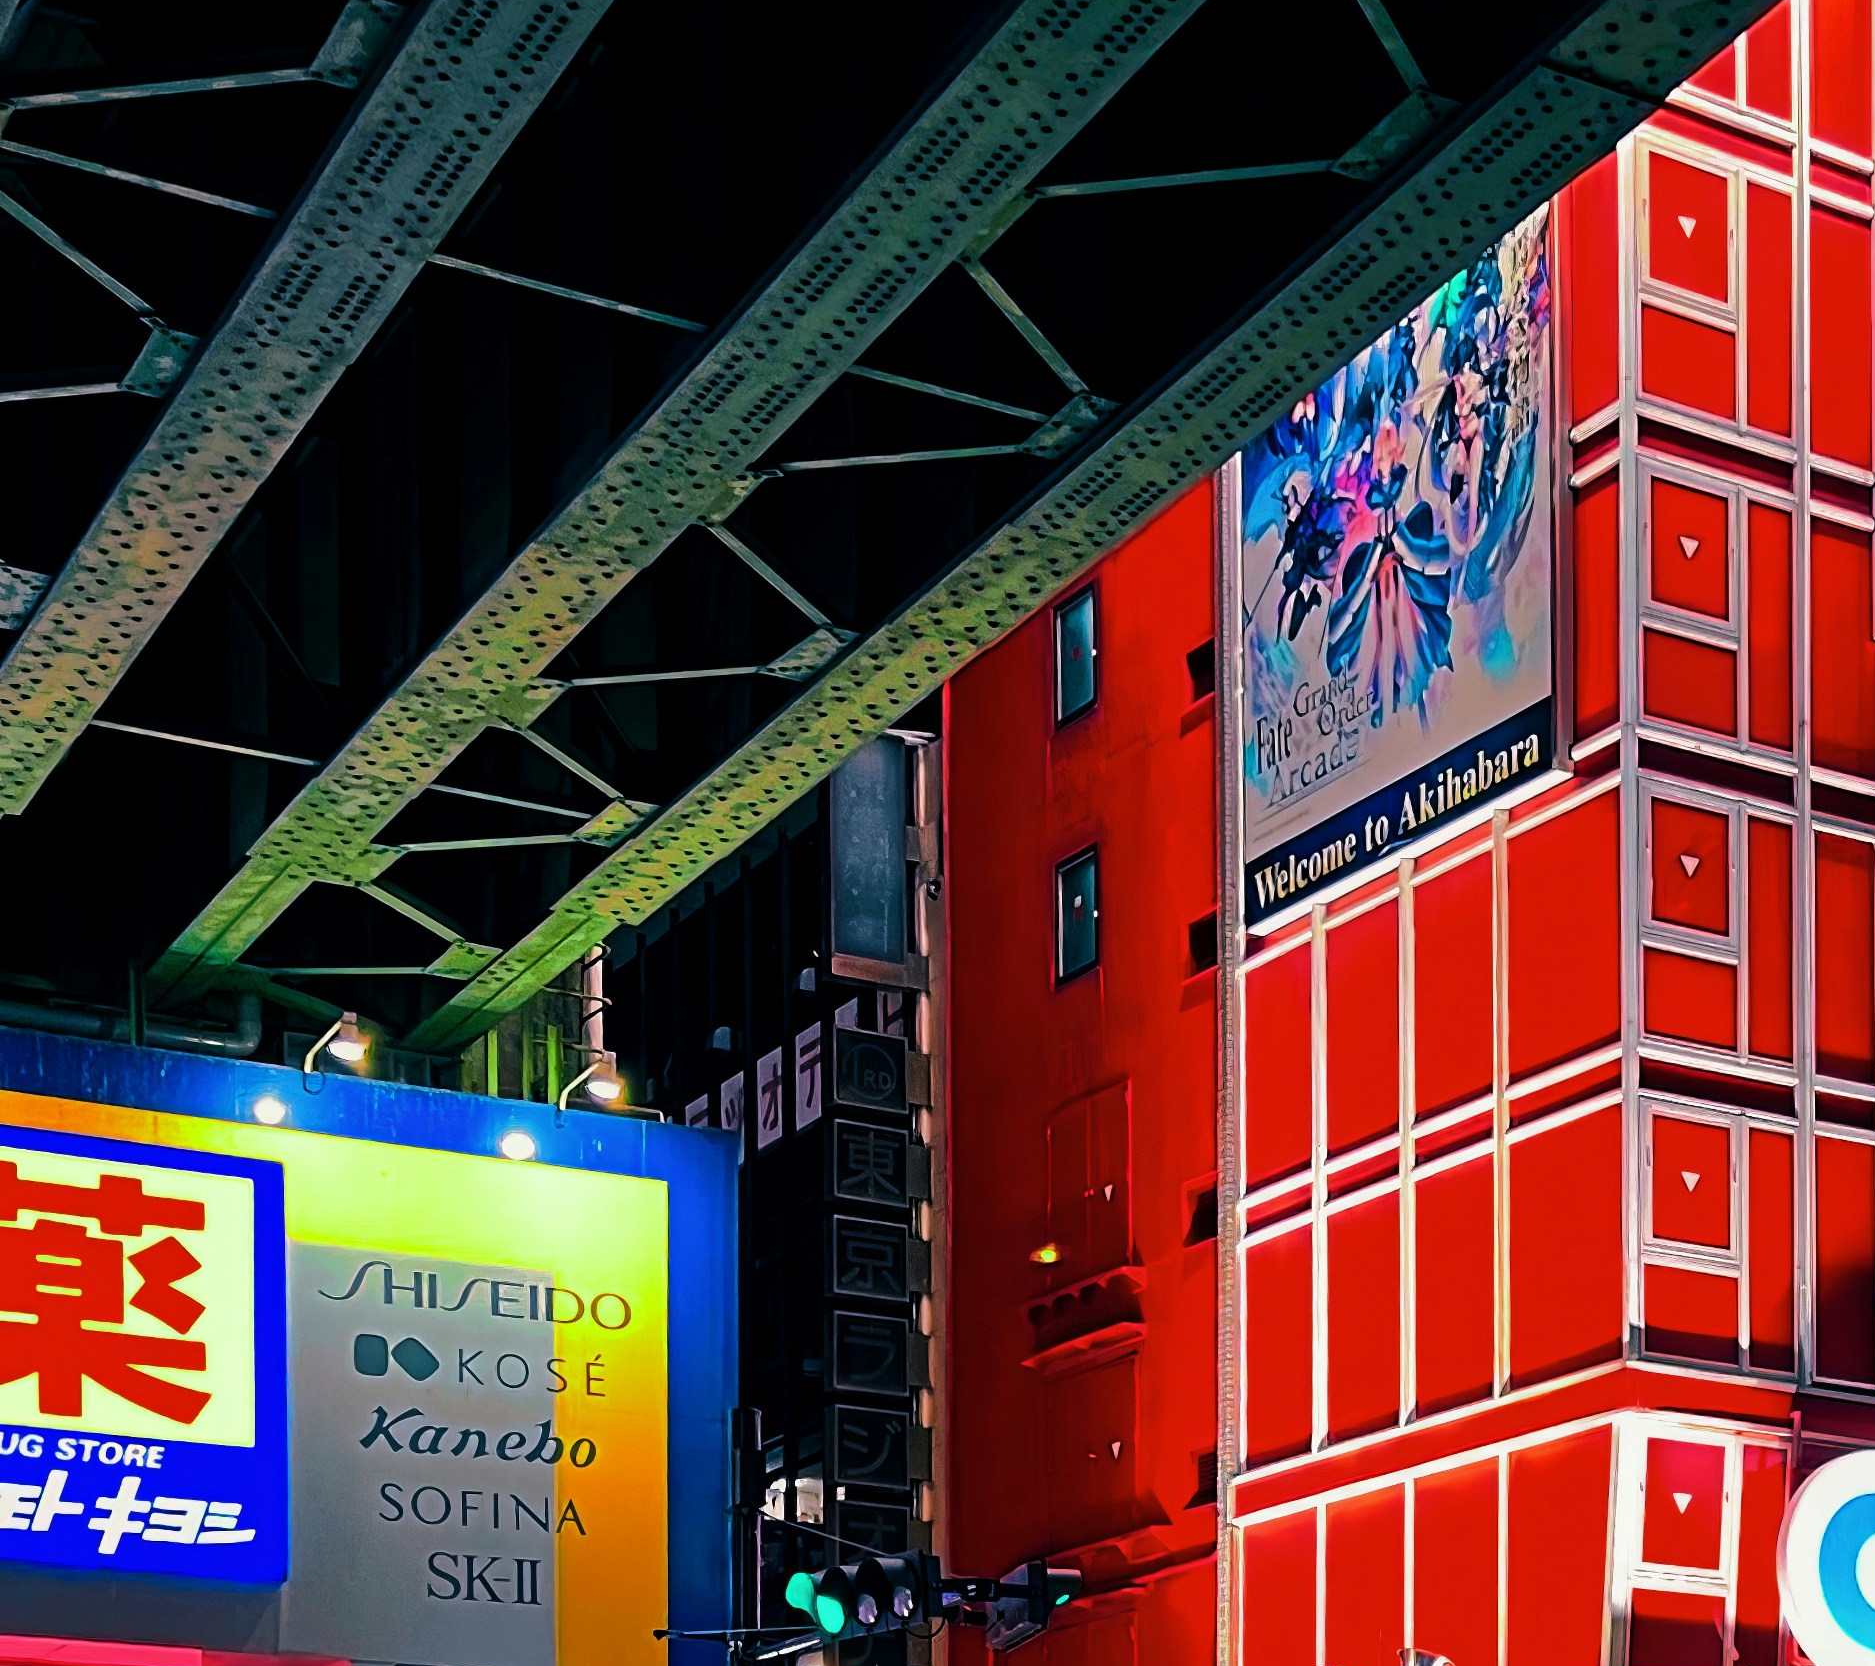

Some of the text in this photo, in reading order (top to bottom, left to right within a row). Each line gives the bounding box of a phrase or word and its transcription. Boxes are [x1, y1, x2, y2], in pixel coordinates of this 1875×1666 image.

[1256, 711, 1293, 775] Fate
[1253, 732, 1541, 911] Welcome to Akihabara
[0, 1160, 212, 1425] 薬
[318, 1260, 632, 1330] SHISEIDO
[458, 1348, 606, 1397] KOSÉ
[55, 1439, 166, 1470] STORE
[358, 1406, 598, 1469] Kanebo
[379, 1482, 587, 1536] SOFINA
[426, 1551, 543, 1608] SK-II
